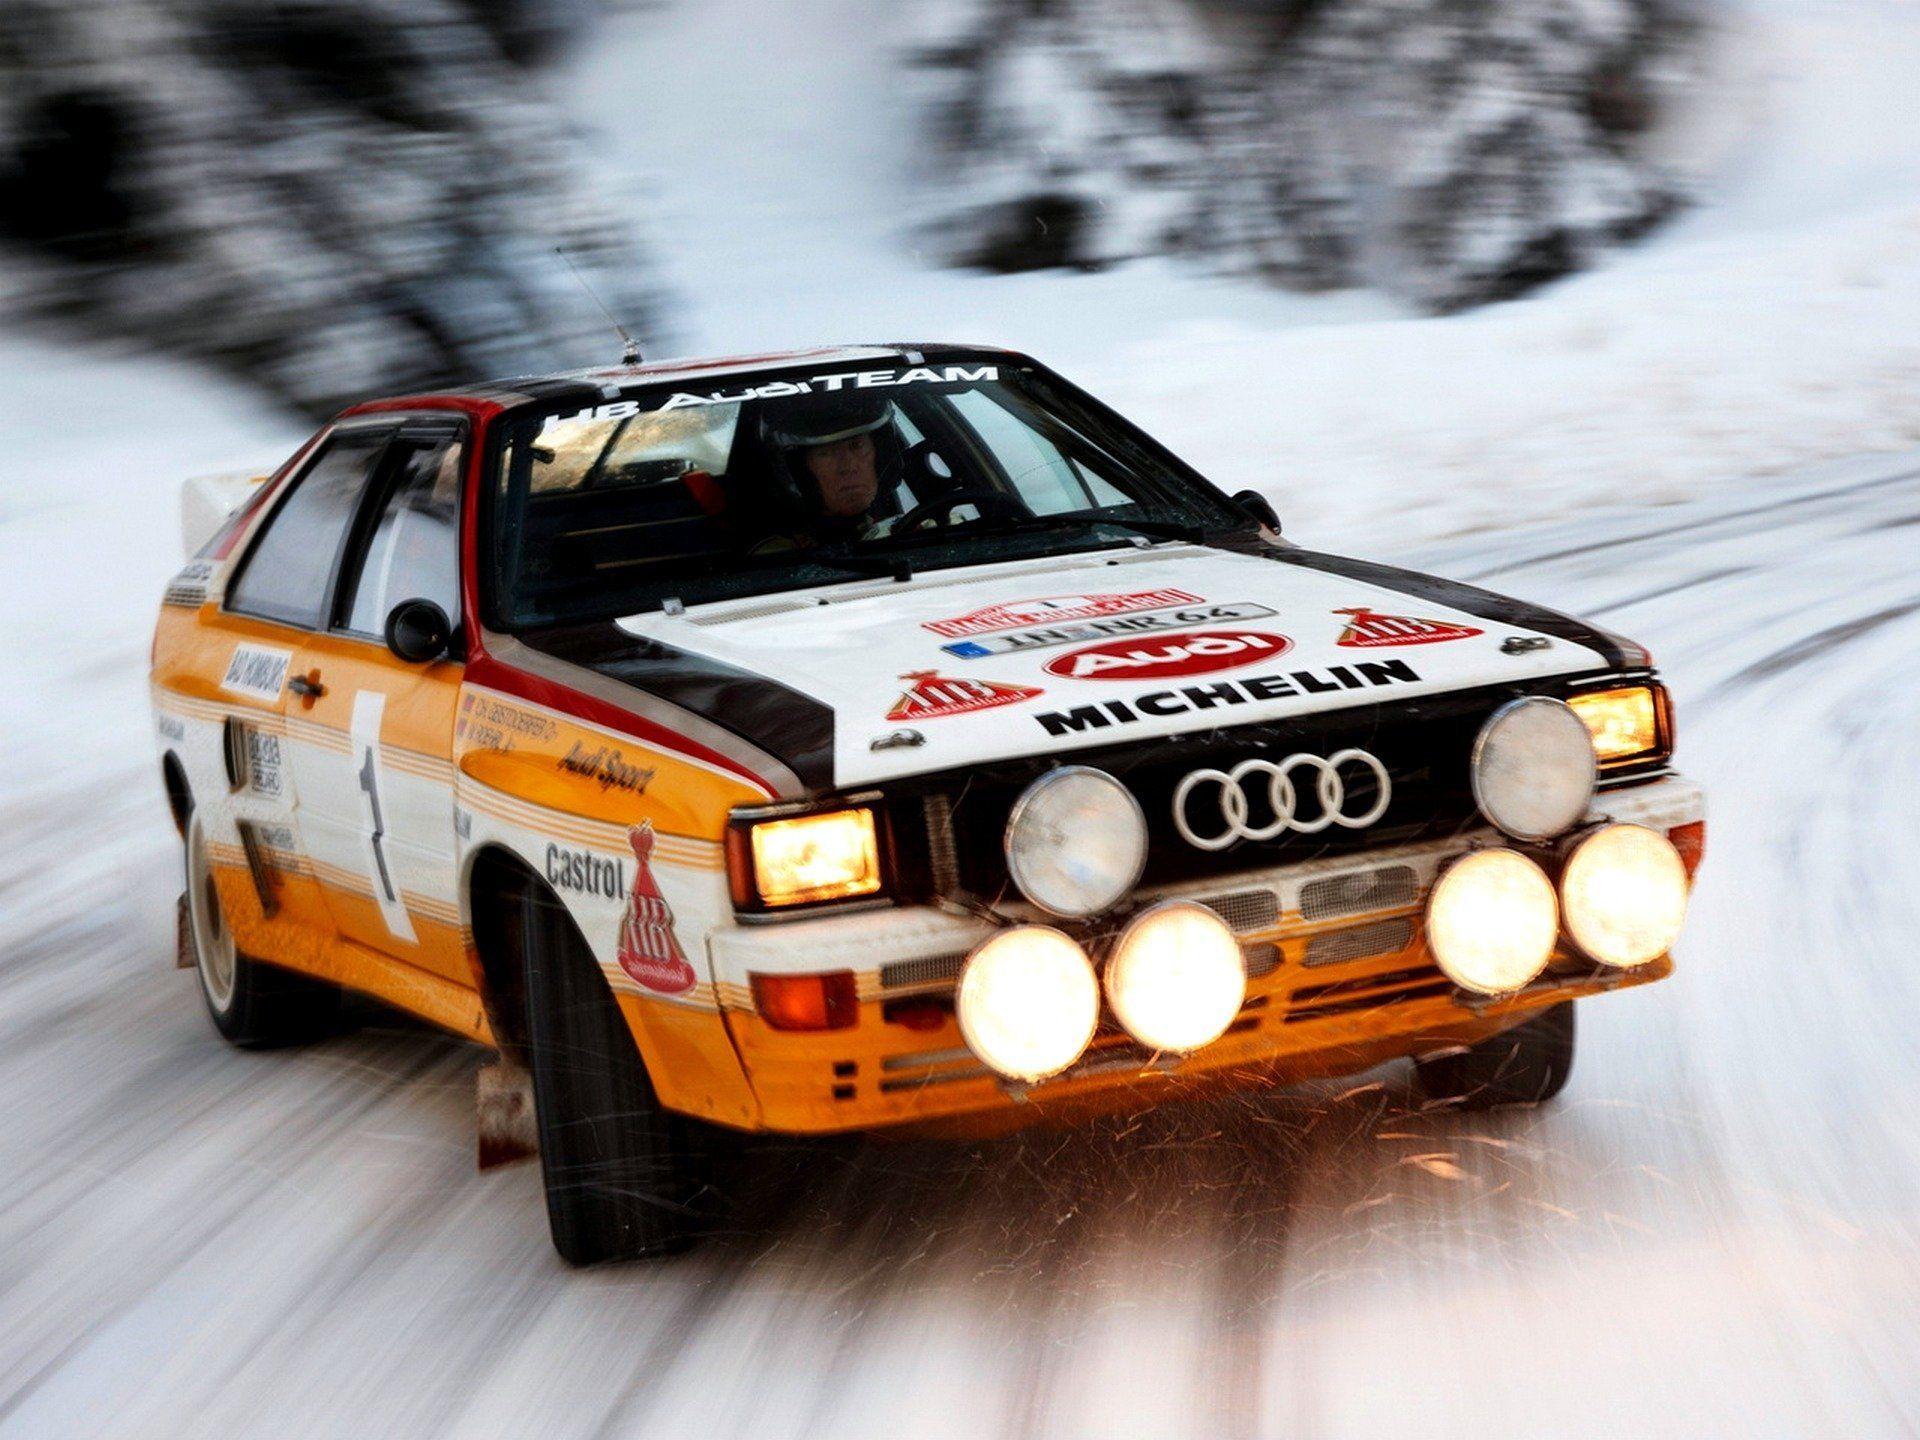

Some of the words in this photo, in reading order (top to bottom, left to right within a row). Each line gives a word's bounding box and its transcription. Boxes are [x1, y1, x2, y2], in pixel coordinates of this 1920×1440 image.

[540, 400, 640, 434] HB
[1175, 608, 1241, 622] 64
[1034, 659, 1422, 736] MICHELIN
[546, 842, 625, 900] Castrol
